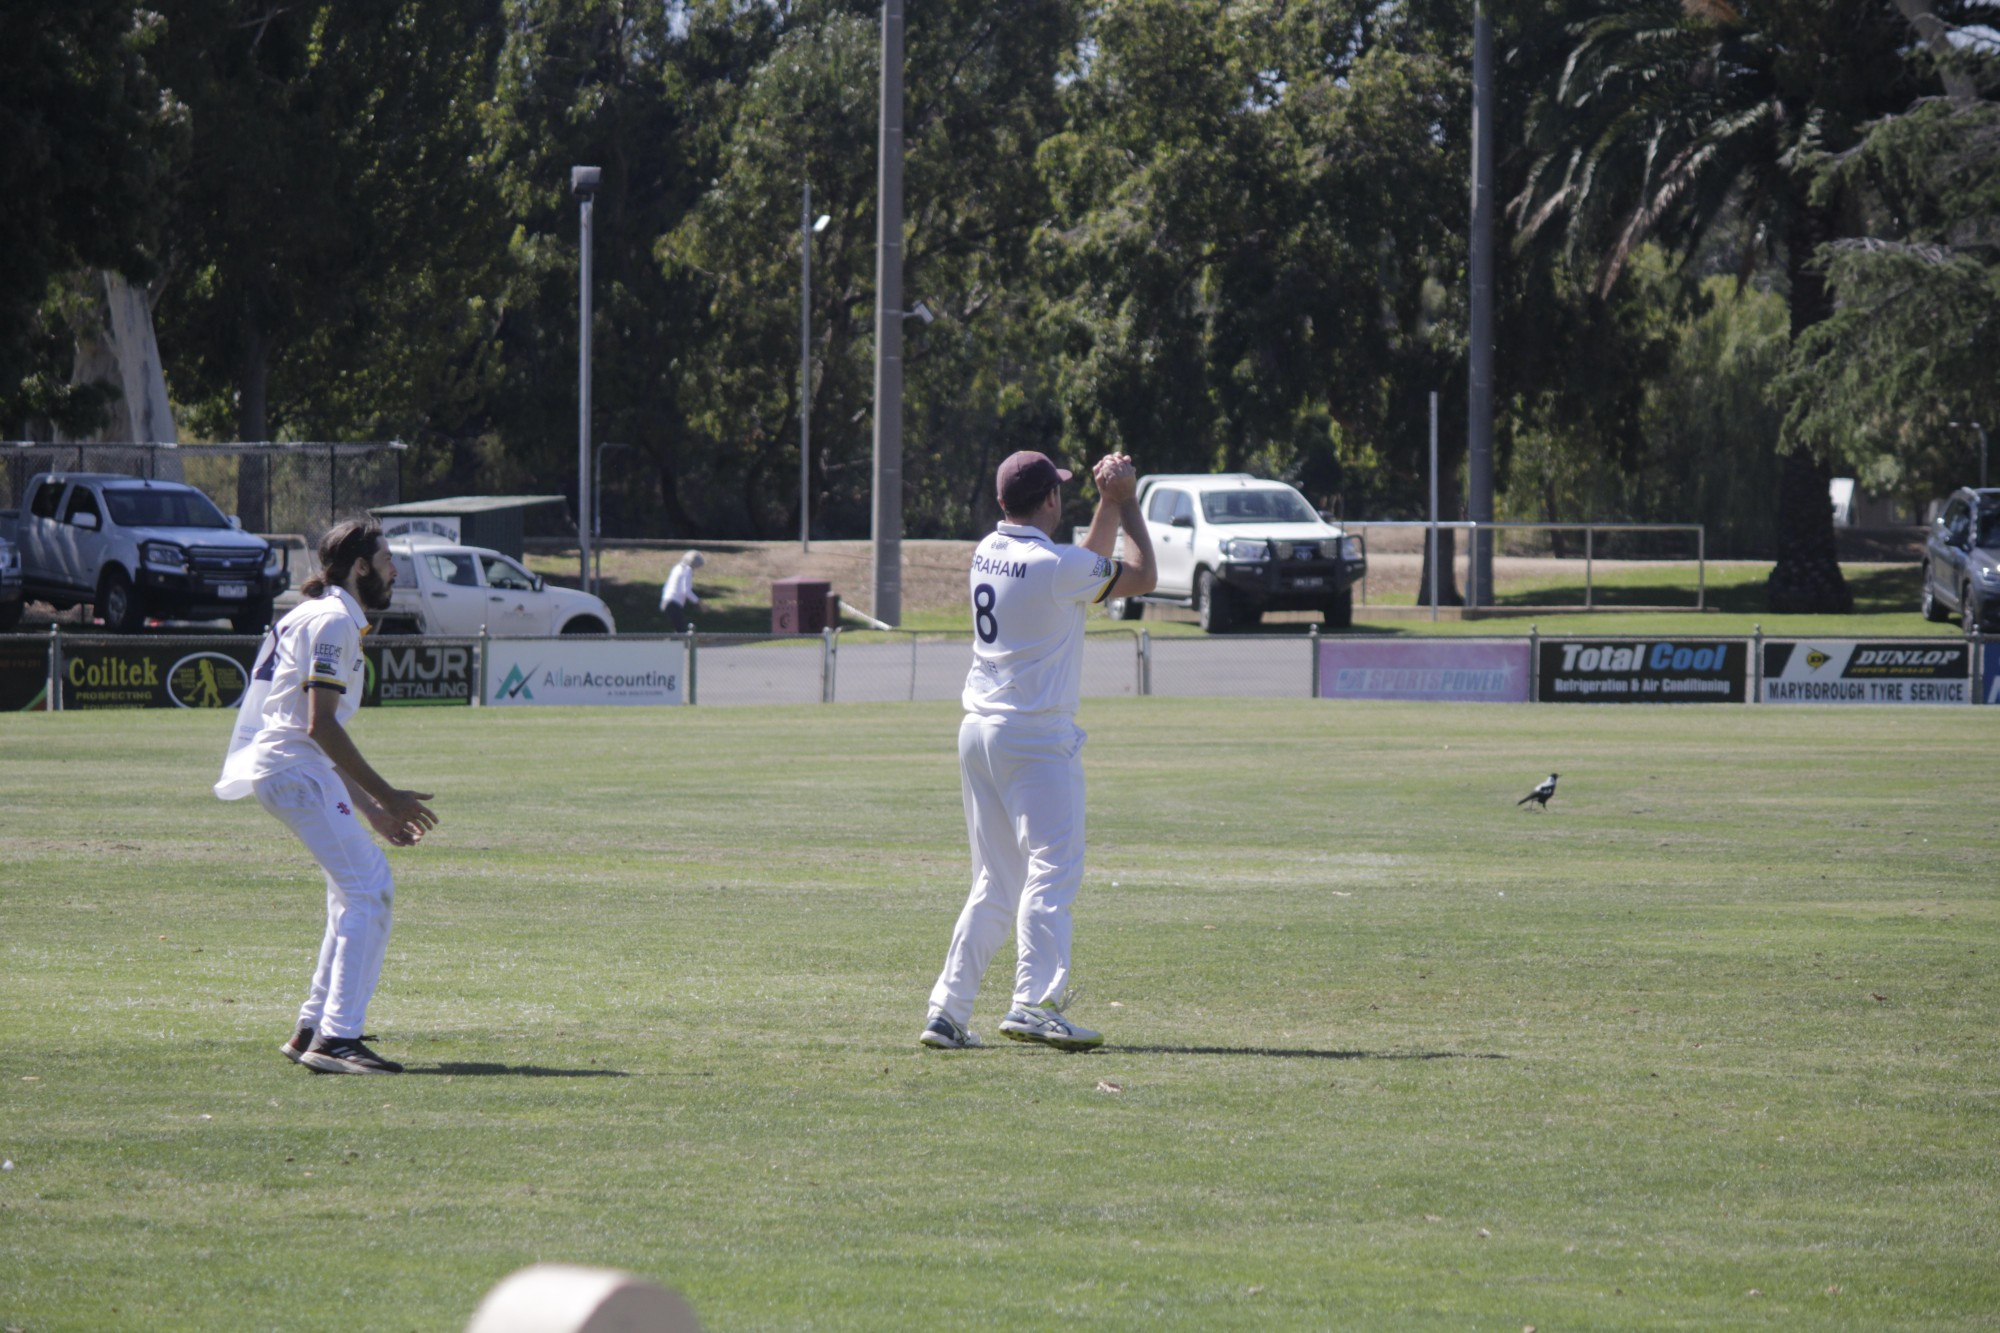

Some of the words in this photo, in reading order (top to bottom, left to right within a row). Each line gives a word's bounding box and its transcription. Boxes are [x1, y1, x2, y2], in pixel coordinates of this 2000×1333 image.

[973, 582, 999, 645] 8
[381, 648, 469, 680] MJR
[1561, 643, 1647, 672] Total
[1649, 642, 1728, 672] Cool
[1855, 650, 1961, 666] DUNLOP
[68, 656, 159, 687] Coiltek
[75, 691, 153, 700] PROSPECTING
[381, 682, 469, 698] DETAILING
[1554, 678, 1629, 694] Refrigeration
[1631, 678, 1640, 692] &
[1642, 678, 1660, 692] Air
[1662, 678, 1731, 694] Conditioning
[1769, 682, 1865, 701] MARYBOROUGH
[1870, 682, 1903, 701] TYRE
[1910, 682, 1964, 701] SERVICE
